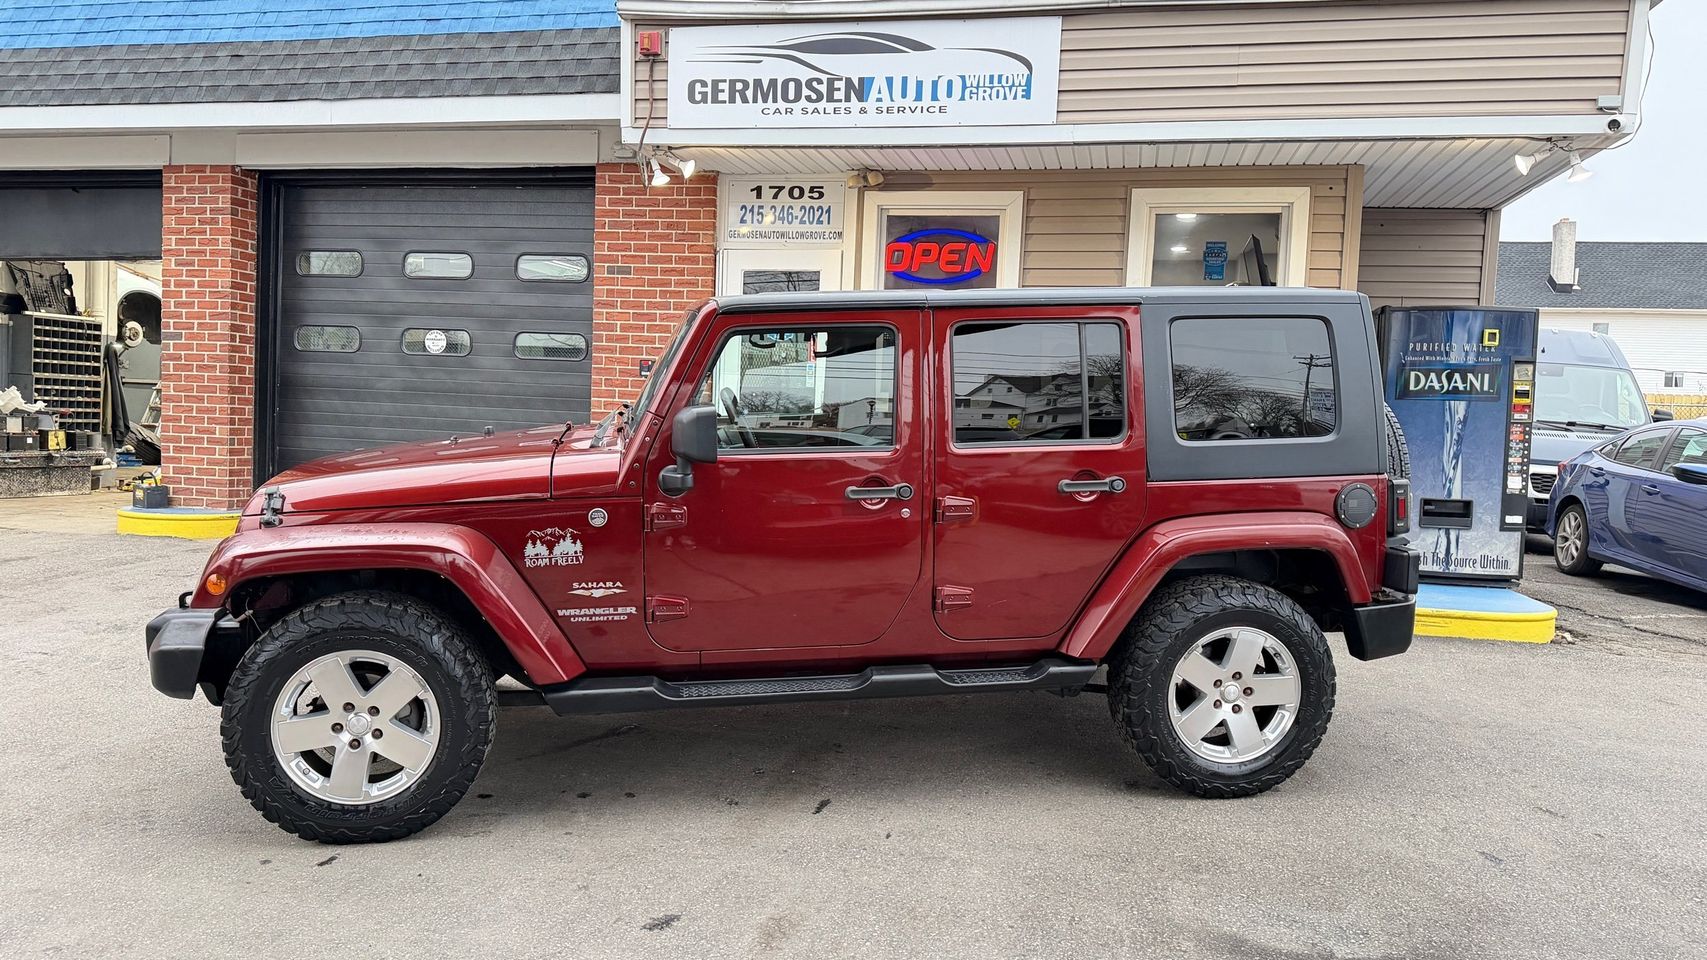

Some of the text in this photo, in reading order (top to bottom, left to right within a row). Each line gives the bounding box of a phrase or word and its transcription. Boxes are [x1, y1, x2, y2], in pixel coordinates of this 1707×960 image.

[965, 73, 1030, 86] WILLOW
[687, 75, 962, 104] GERMOSEN AUTO
[965, 86, 1028, 101] GROVE
[761, 105, 948, 115] CAR SALES & SERVICE
[750, 185, 825, 200] 1705
[739, 204, 832, 225] 215-346-2021
[885, 242, 995, 272] OPEN
[1409, 342, 1457, 352] PURIFIED
[1409, 369, 1491, 394] DASANI
[524, 556, 584, 568] ROAM FREELY
[1431, 552, 1447, 568] The
[1449, 553, 1477, 569] Source
[1479, 554, 1511, 570] Within.
[572, 581, 623, 589] SAHARA
[557, 606, 637, 616] WRANGLER
